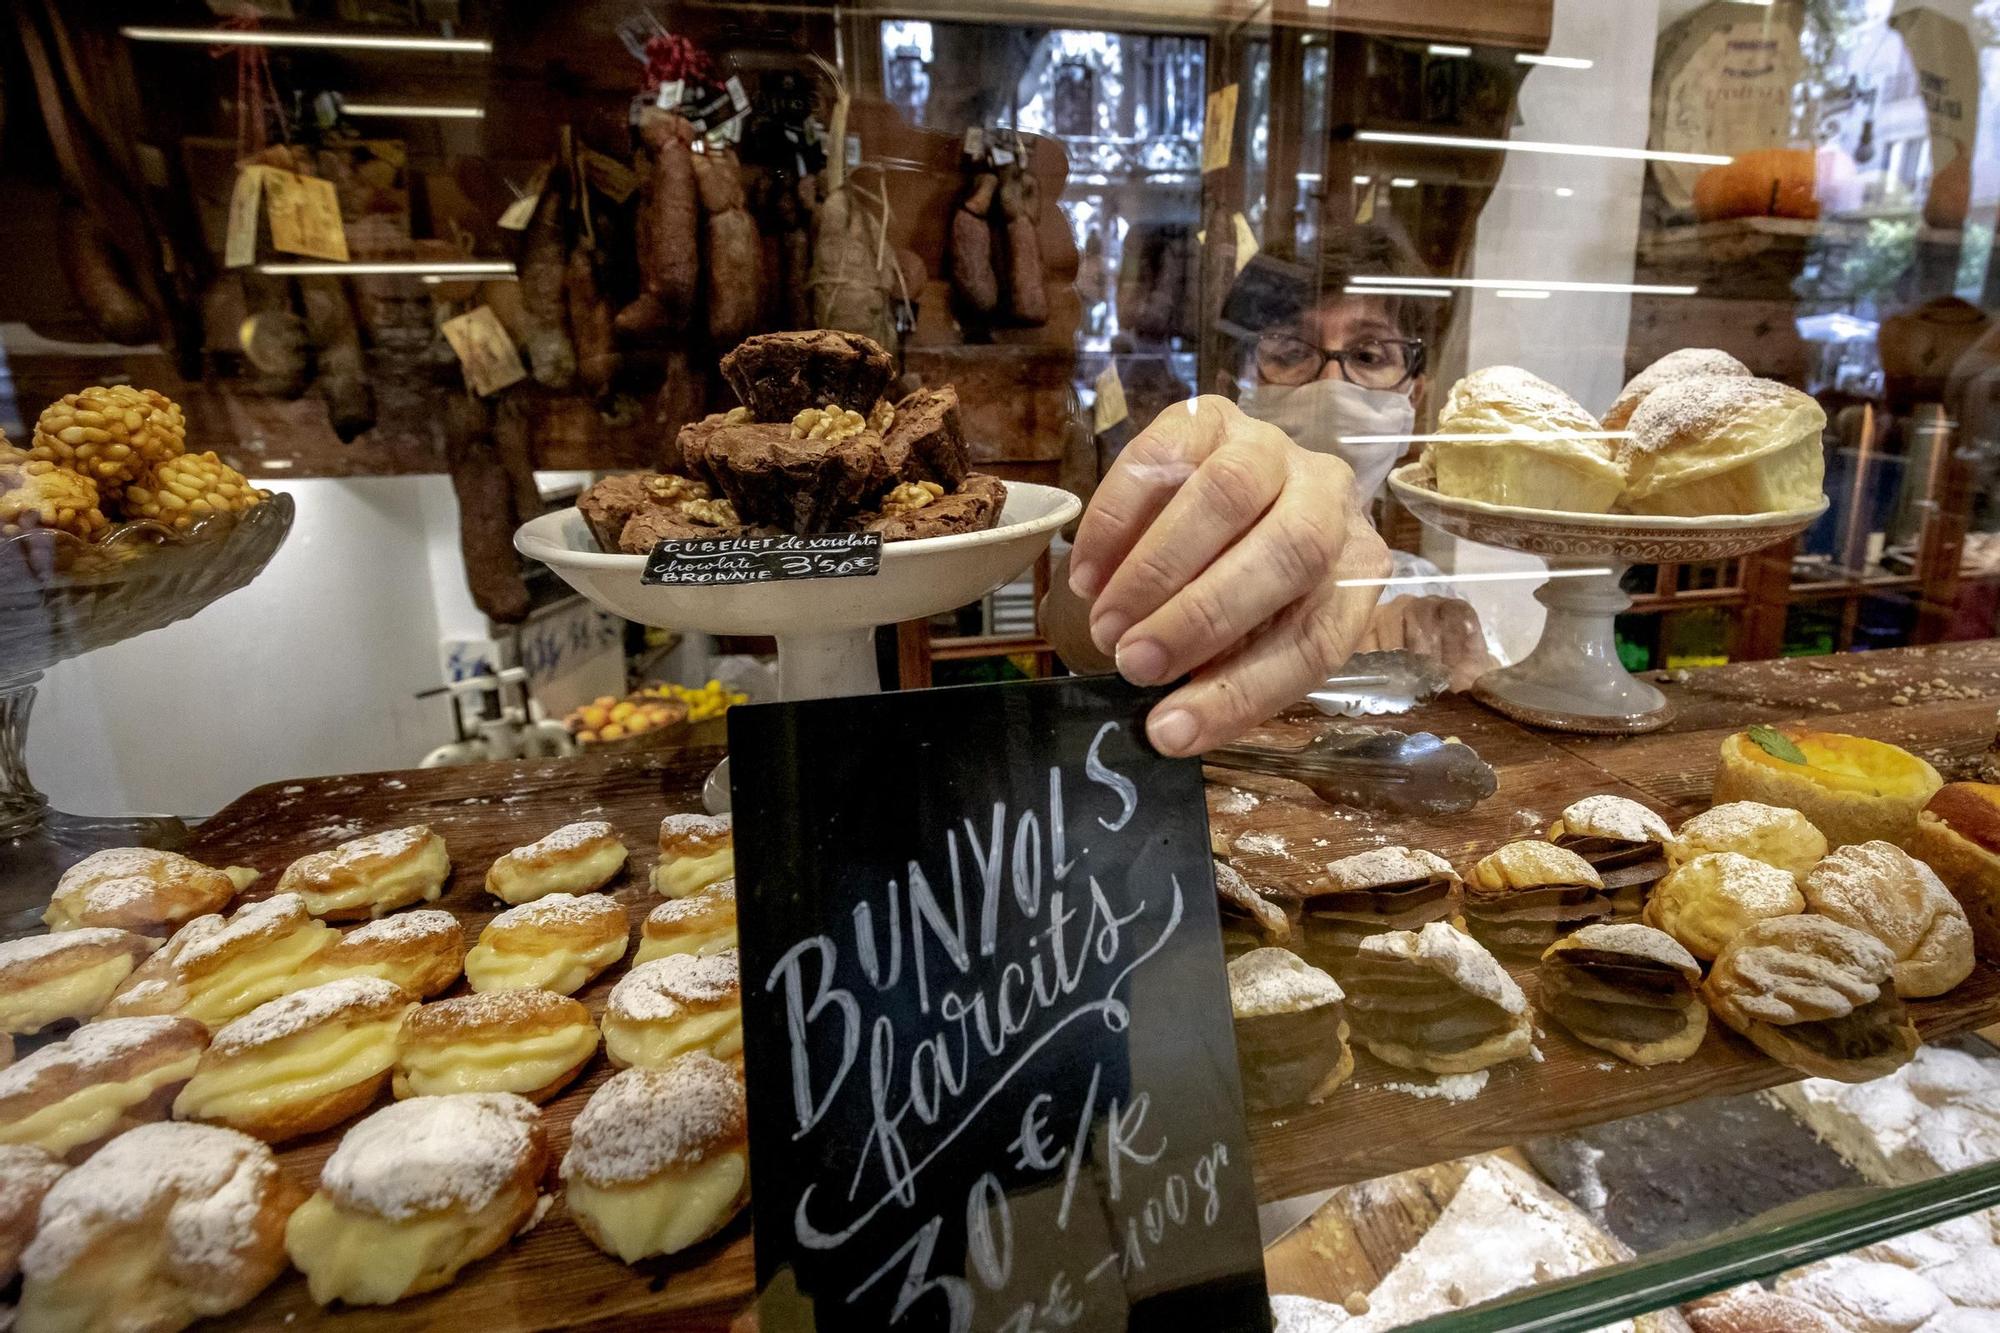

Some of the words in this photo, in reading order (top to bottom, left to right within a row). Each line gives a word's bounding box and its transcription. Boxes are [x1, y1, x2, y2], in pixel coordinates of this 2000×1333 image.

[776, 535, 804, 550] de
[804, 533, 878, 549] xocolata
[653, 554, 765, 574] chocolate
[661, 570, 773, 583] BROWNIE
[764, 720, 1138, 1141] BUNYOLS
[849, 874, 1146, 1208] farcits
